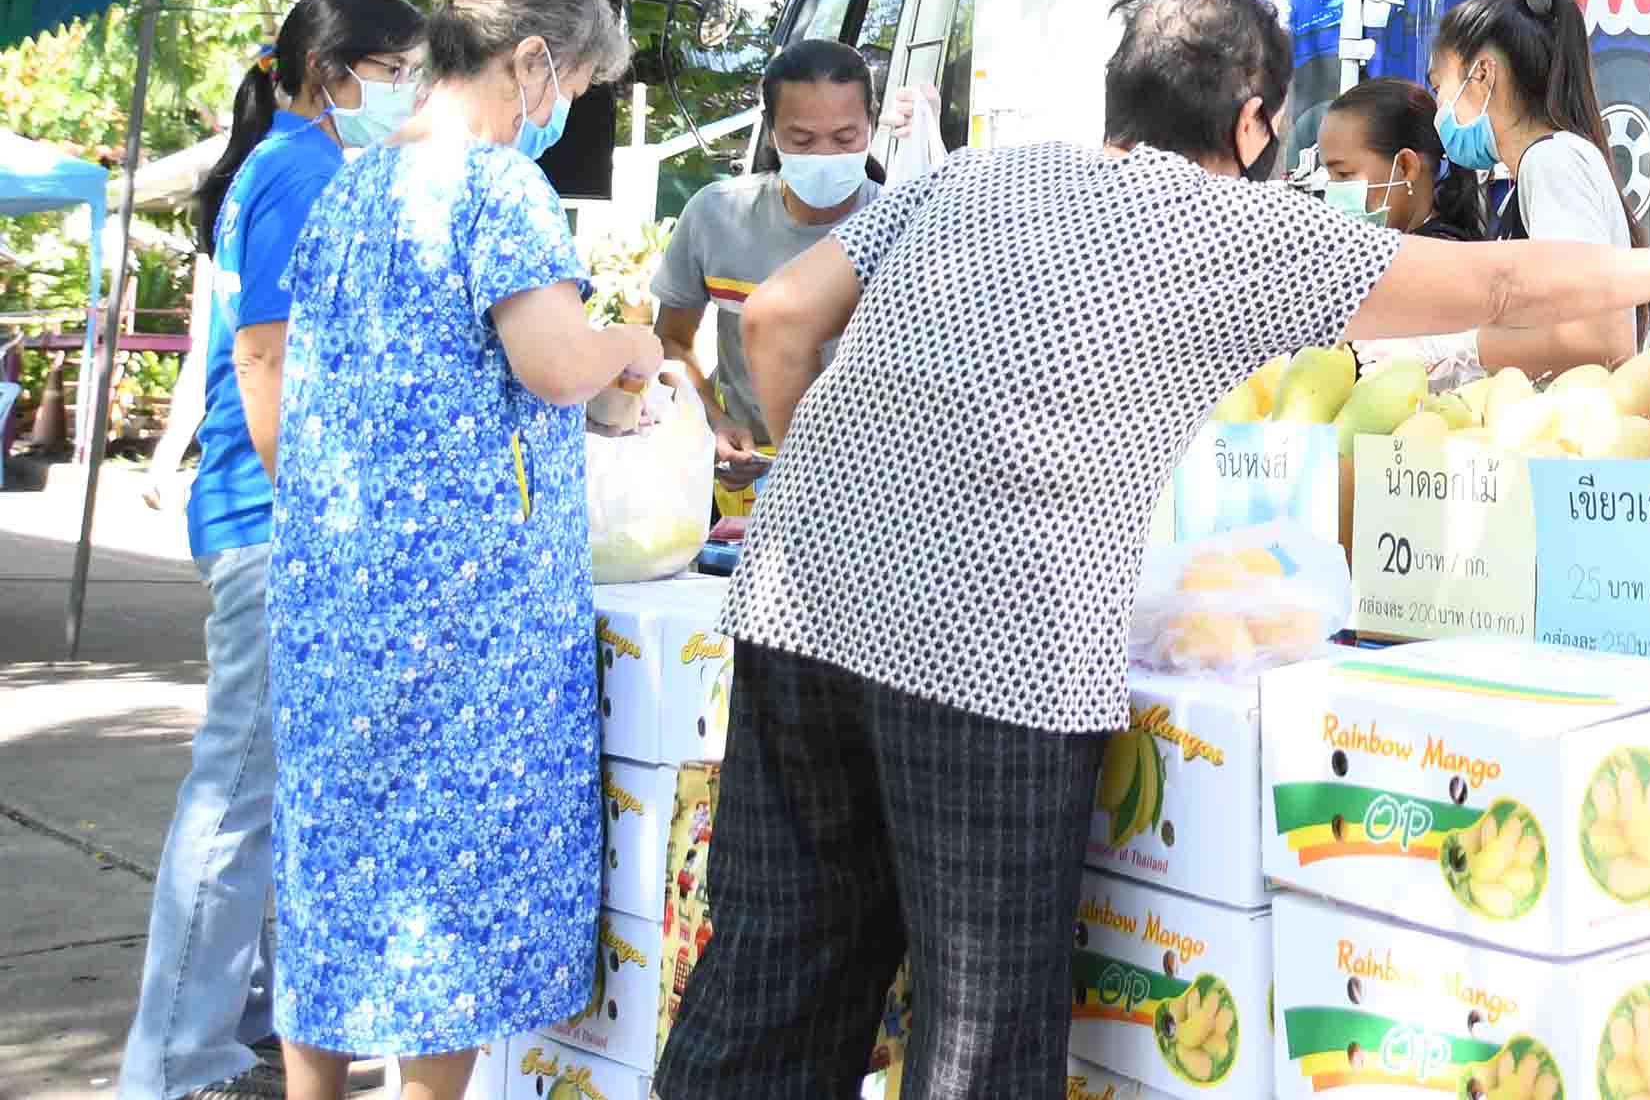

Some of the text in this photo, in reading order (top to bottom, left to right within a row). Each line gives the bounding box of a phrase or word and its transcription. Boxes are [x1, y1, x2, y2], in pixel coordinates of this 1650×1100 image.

[1384, 438, 1499, 503] น้ำดอกไม้
[1567, 562, 1601, 603] 25
[1607, 579, 1645, 601] บาท
[1322, 711, 1503, 790] Rainbow Mango
[1078, 896, 1208, 965] ainbow Mango
